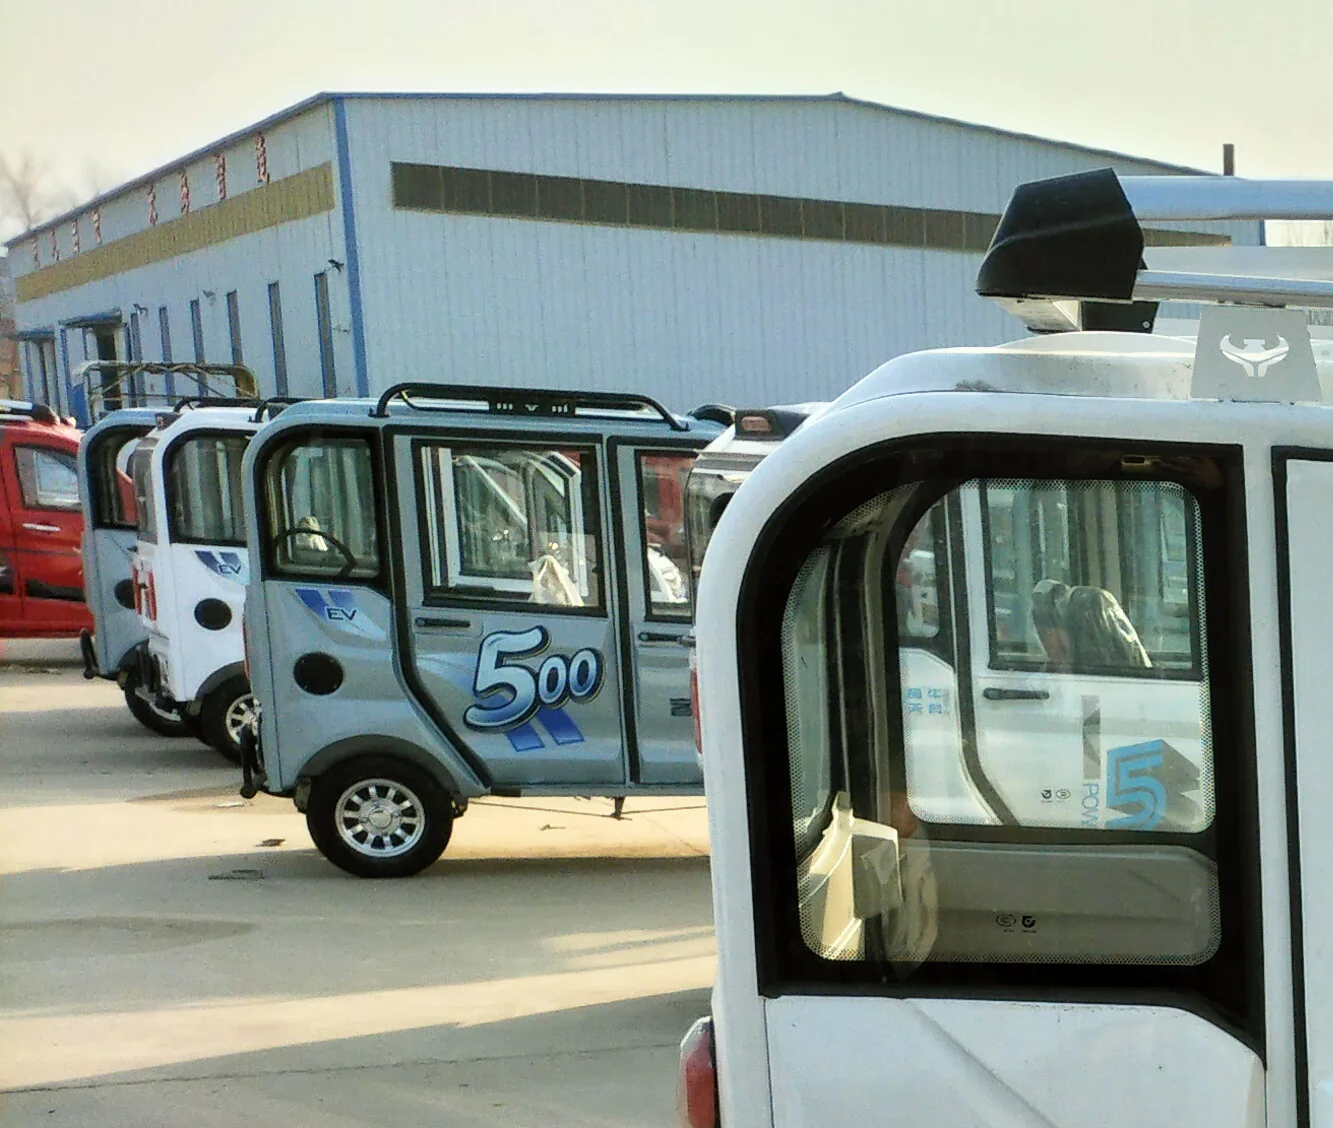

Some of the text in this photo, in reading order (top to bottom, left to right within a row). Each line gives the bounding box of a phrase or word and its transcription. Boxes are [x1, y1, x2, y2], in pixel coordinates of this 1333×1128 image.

[218, 564, 242, 575] EV
[327, 608, 358, 621] EV
[463, 625, 606, 733] 500
